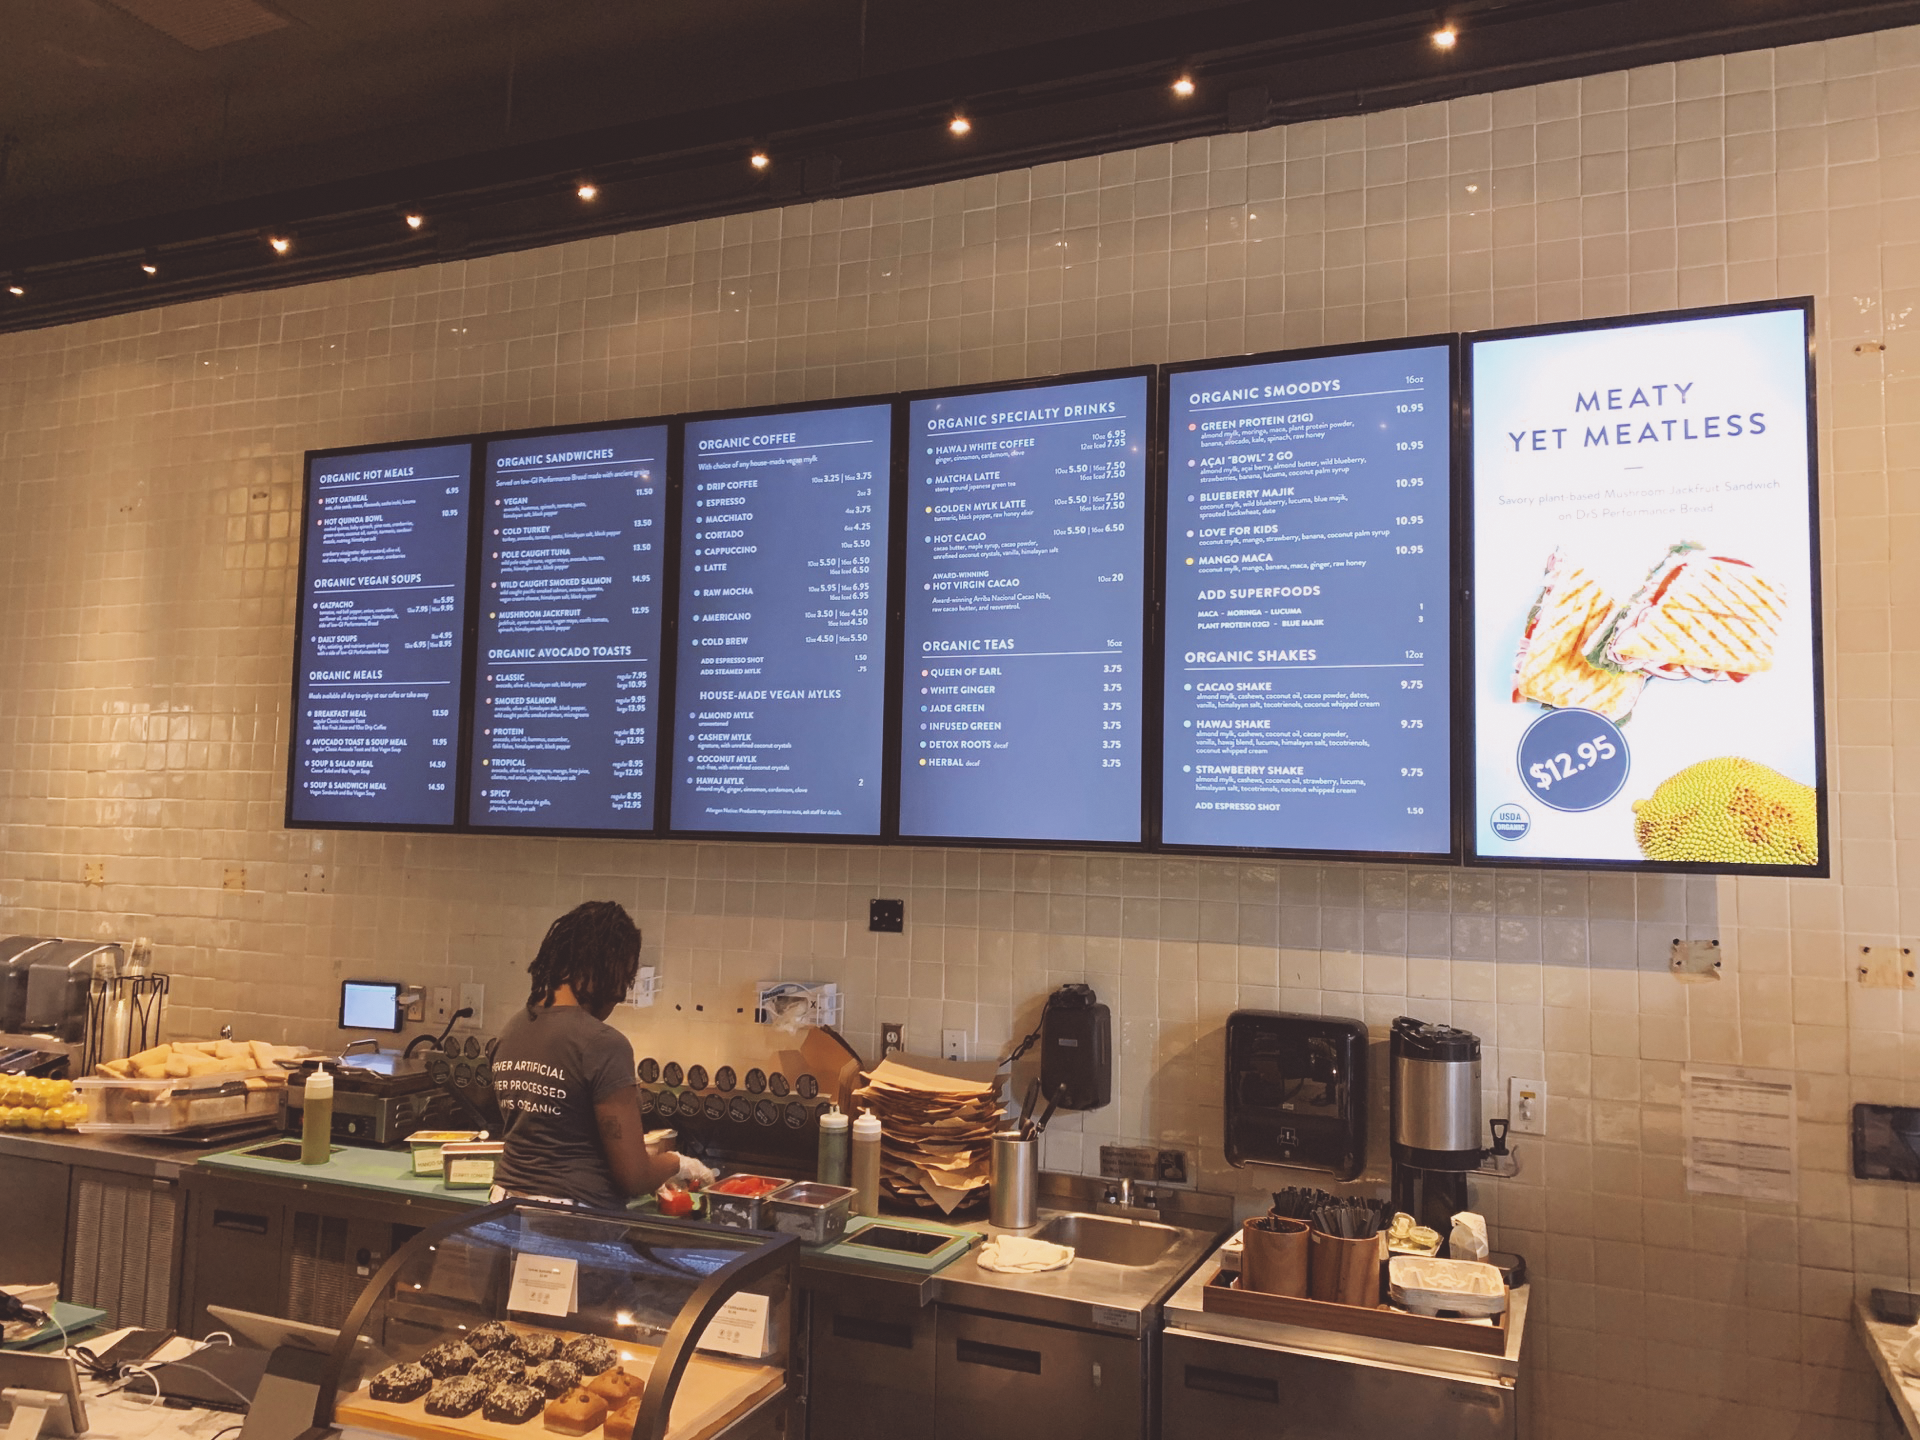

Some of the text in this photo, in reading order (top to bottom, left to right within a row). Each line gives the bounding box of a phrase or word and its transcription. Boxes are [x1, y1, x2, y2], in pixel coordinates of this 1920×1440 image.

[1190, 379, 1340, 404] ORGANIC SMOODYS
[1575, 382, 1694, 412] MEATY
[1396, 403, 1423, 413] 10.95
[928, 401, 1115, 429] ORGANIC SPECIALTY DRINKS
[1201, 412, 1313, 430] GREEN PROTEIN (21G)
[1107, 429, 1125, 438] 6.95
[1508, 412, 1767, 452] YET MEATLESS
[699, 432, 795, 449] ORGANIC COFFEE
[1107, 438, 1125, 447] 7.95
[1396, 440, 1423, 450] 10.95
[936, 438, 1034, 454] HAWAJ WHITE COFFEE
[497, 448, 613, 466] ORGANIC SANDWICHES
[1200, 456, 1224, 467] AÇAI
[1268, 452, 1273, 460] 2
[1276, 451, 1292, 460] GO
[935, 471, 1000, 483] MATCHA LATTE
[1396, 477, 1423, 487] 10.95
[707, 479, 757, 490] DRIP COFFEE
[1200, 487, 1294, 501] BLUEBERRY MAJIK
[1498, 479, 1780, 507] Savory plant-based Mushroom Jackfruit Sandwich
[706, 497, 745, 506] ESPRESSO
[935, 499, 1026, 513] GOLDEN MYLK LATTE
[706, 512, 753, 523] MACCHIATO
[1396, 515, 1423, 524] 10.95
[523, 525, 550, 533] TURKEY
[1200, 524, 1278, 537] LOVE FOR KIDS
[705, 530, 743, 539] CORTADO
[934, 532, 986, 542] HOT CACAO
[704, 545, 756, 555] CAPPUCCINO
[1396, 545, 1423, 554] 10.95
[1199, 553, 1272, 564] MANGO MACA
[704, 563, 726, 571] LATTE
[933, 570, 989, 579] AWARD-WINNING
[1112, 573, 1123, 581] 20
[933, 578, 1019, 589] HOT VIRGIN CACAO
[703, 587, 753, 596] RAW MOCHA
[1198, 585, 1320, 599] ADD SUPERFOODS
[702, 612, 751, 621] AMERICANO
[923, 638, 1014, 651] ORGANIC TEAS
[489, 645, 631, 658] ORGANIC AVOCADO TOASTS
[1185, 649, 1316, 662] ORGANIC SHAKES
[931, 668, 962, 677] QUEEN
[980, 667, 1002, 675] EARL
[1104, 664, 1122, 672] 3.75
[496, 673, 524, 681] CLASSIC
[1104, 683, 1121, 691] 3.75
[1197, 682, 1271, 691] CACAO SHAKE
[1401, 680, 1422, 688] 9.75
[700, 689, 841, 699] HOUSE-MADE VEGAN MYLKS
[930, 685, 995, 694] WHITE GINGER
[930, 704, 952, 712] JADE
[930, 722, 1001, 730] INFUSED GREEN
[1197, 720, 1270, 728] HAWAJ SHAKE
[1401, 719, 1422, 728] 9.75
[930, 740, 958, 748] DETOX
[961, 740, 991, 748] ROOTS
[929, 758, 963, 766] HERBAL
[1530, 735, 1616, 790] $12.95
[1196, 765, 1303, 774] STRAWBERRY SHAKE
[1401, 767, 1423, 776] 9.75
[490, 789, 510, 797] SPICY
[1215, 802, 1256, 810] ESPRESSO
[1500, 812, 1522, 820] USDA
[1496, 822, 1525, 831] ORGANIC
[514, 1061, 565, 1080] ARTIFICIAL
[511, 1080, 566, 1099] PROCESSED
